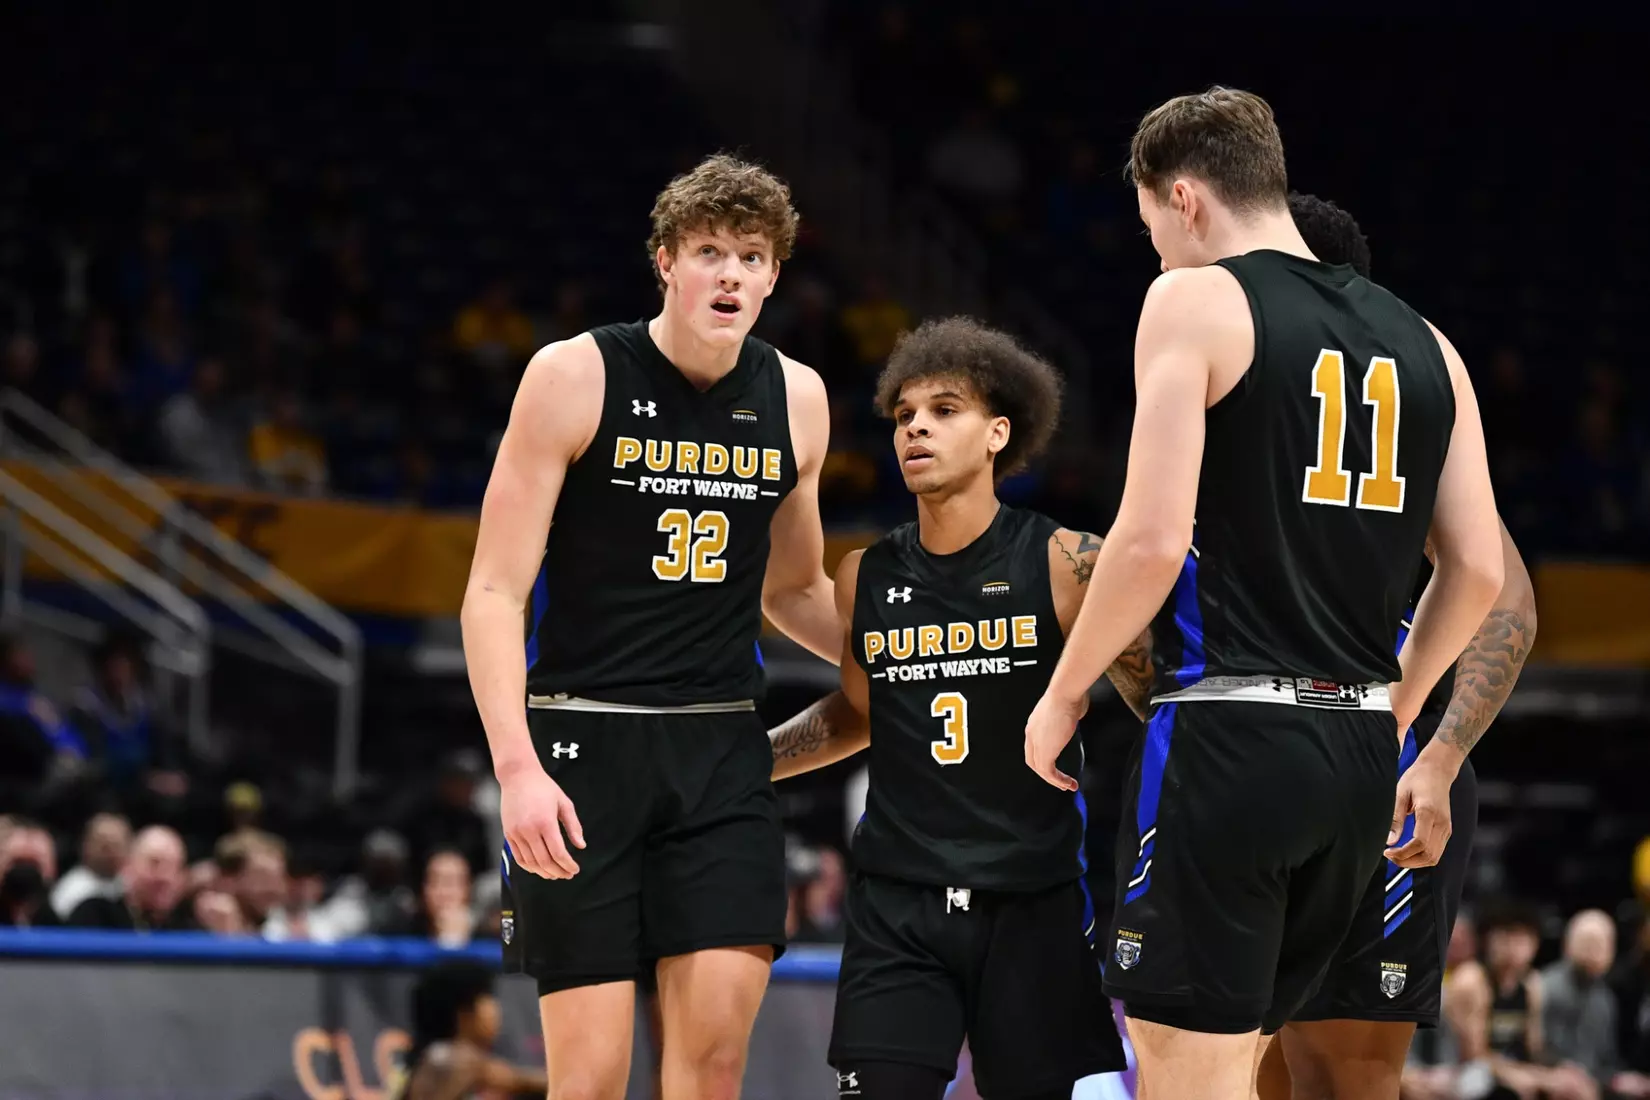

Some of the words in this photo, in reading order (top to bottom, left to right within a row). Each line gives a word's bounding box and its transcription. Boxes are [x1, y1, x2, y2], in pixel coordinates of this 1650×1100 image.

[732, 413, 758, 422] HORIZON
[1302, 348, 1406, 514] 11
[613, 436, 782, 481] PURDUE
[638, 476, 691, 495] FORT
[692, 479, 758, 500] WAYNE
[651, 508, 730, 583] 32
[982, 585, 1010, 593] HORIZON
[863, 615, 1038, 664] PURDUE
[885, 662, 938, 682] FORT
[939, 657, 1011, 678] WAYNE
[930, 691, 969, 765] 3
[1117, 929, 1144, 940] PURDUE
[1380, 961, 1407, 970] PURDUE
